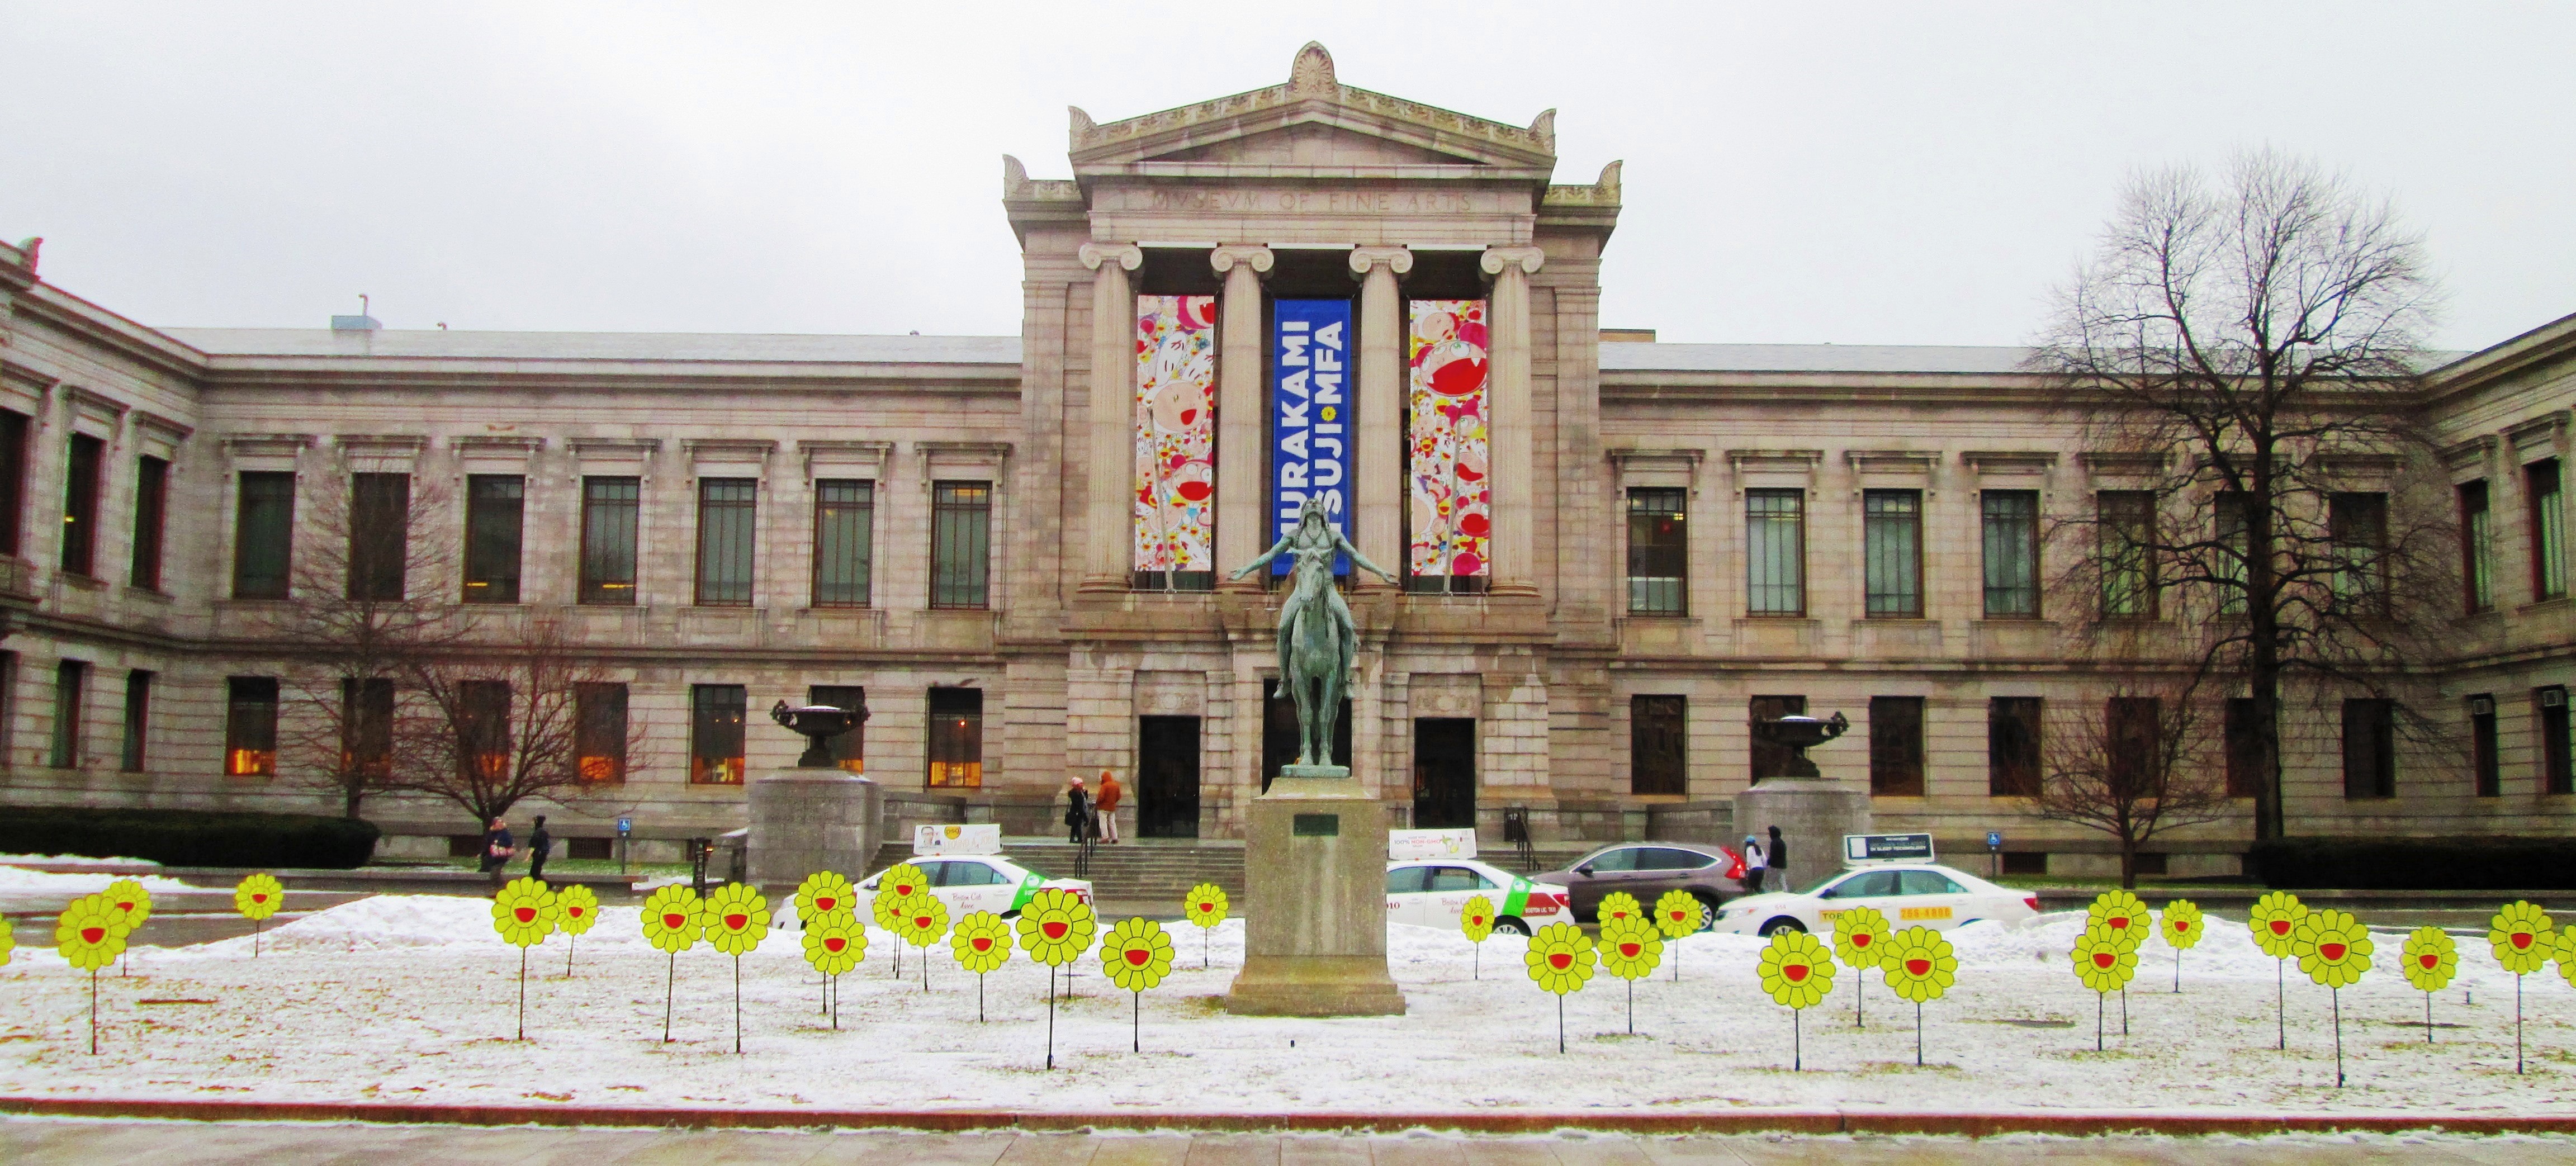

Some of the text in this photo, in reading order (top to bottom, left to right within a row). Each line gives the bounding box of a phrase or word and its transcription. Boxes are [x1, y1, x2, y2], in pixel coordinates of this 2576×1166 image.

[1280, 193, 1307, 211] OF
[1329, 193, 1390, 211] FINE
[1407, 193, 1471, 211] ARTS
[1315, 321, 1342, 533] SUJI MFA
